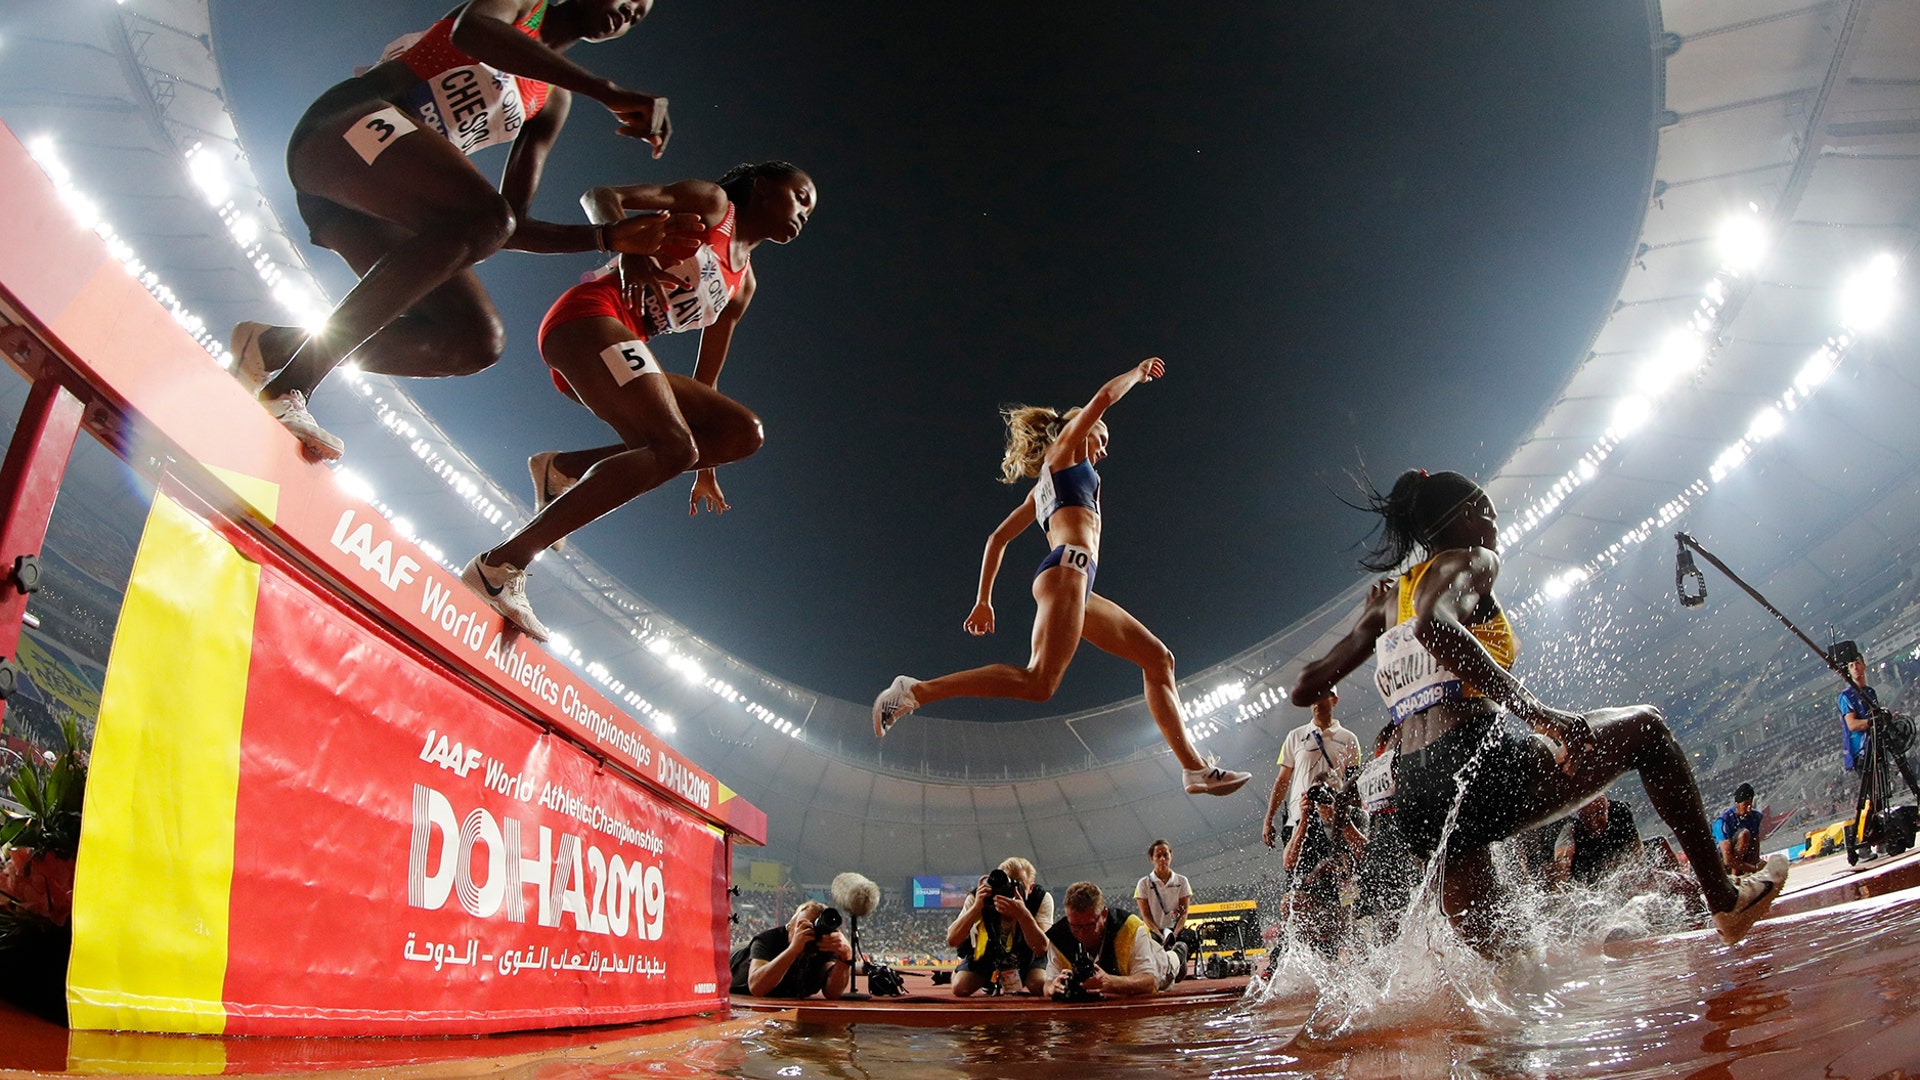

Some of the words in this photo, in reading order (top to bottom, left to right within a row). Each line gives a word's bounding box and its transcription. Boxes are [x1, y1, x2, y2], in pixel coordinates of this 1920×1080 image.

[502, 90, 523, 132] QNB
[365, 118, 396, 143] 3
[621, 347, 646, 372] 5
[1068, 549, 1088, 569] 10
[330, 509, 421, 592] IAAF
[421, 575, 489, 652] World
[484, 631, 560, 706] Athletics
[560, 684, 651, 767] Championships
[657, 751, 710, 809] DOHA2019
[1376, 651, 1441, 698] CHEMUT
[419, 729, 483, 778] IAAF
[483, 756, 535, 803] World
[538, 780, 592, 825] Athletics
[592, 804, 664, 855] Championships
[408, 782, 665, 941] DOHA2019
[403, 932, 479, 972] الدوحة
[499, 945, 549, 976] القوى
[600, 954, 634, 978] العالم
[636, 955, 667, 980] بطولة
